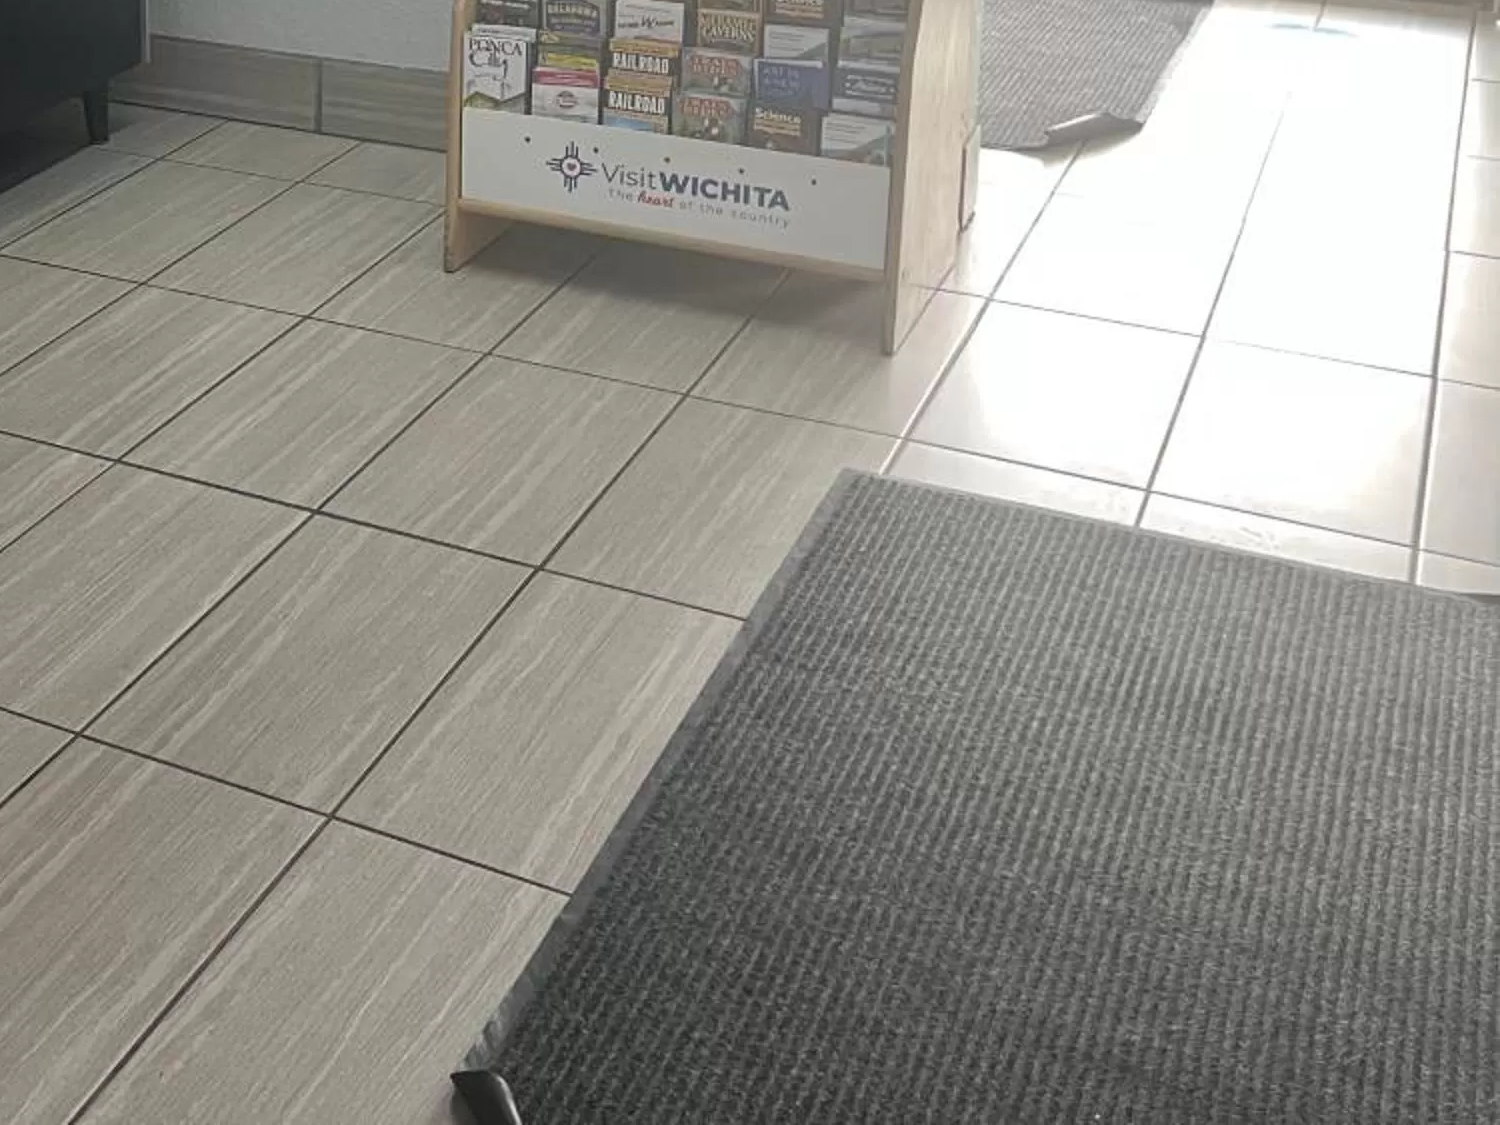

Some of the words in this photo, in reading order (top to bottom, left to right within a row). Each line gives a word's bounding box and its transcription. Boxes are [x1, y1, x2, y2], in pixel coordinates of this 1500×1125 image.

[608, 90, 665, 114] RAILROAD
[601, 162, 656, 189] Visit
[659, 171, 790, 211] WICHITA
[637, 190, 675, 208] heart
[699, 203, 723, 216] the
[731, 209, 790, 230] country
